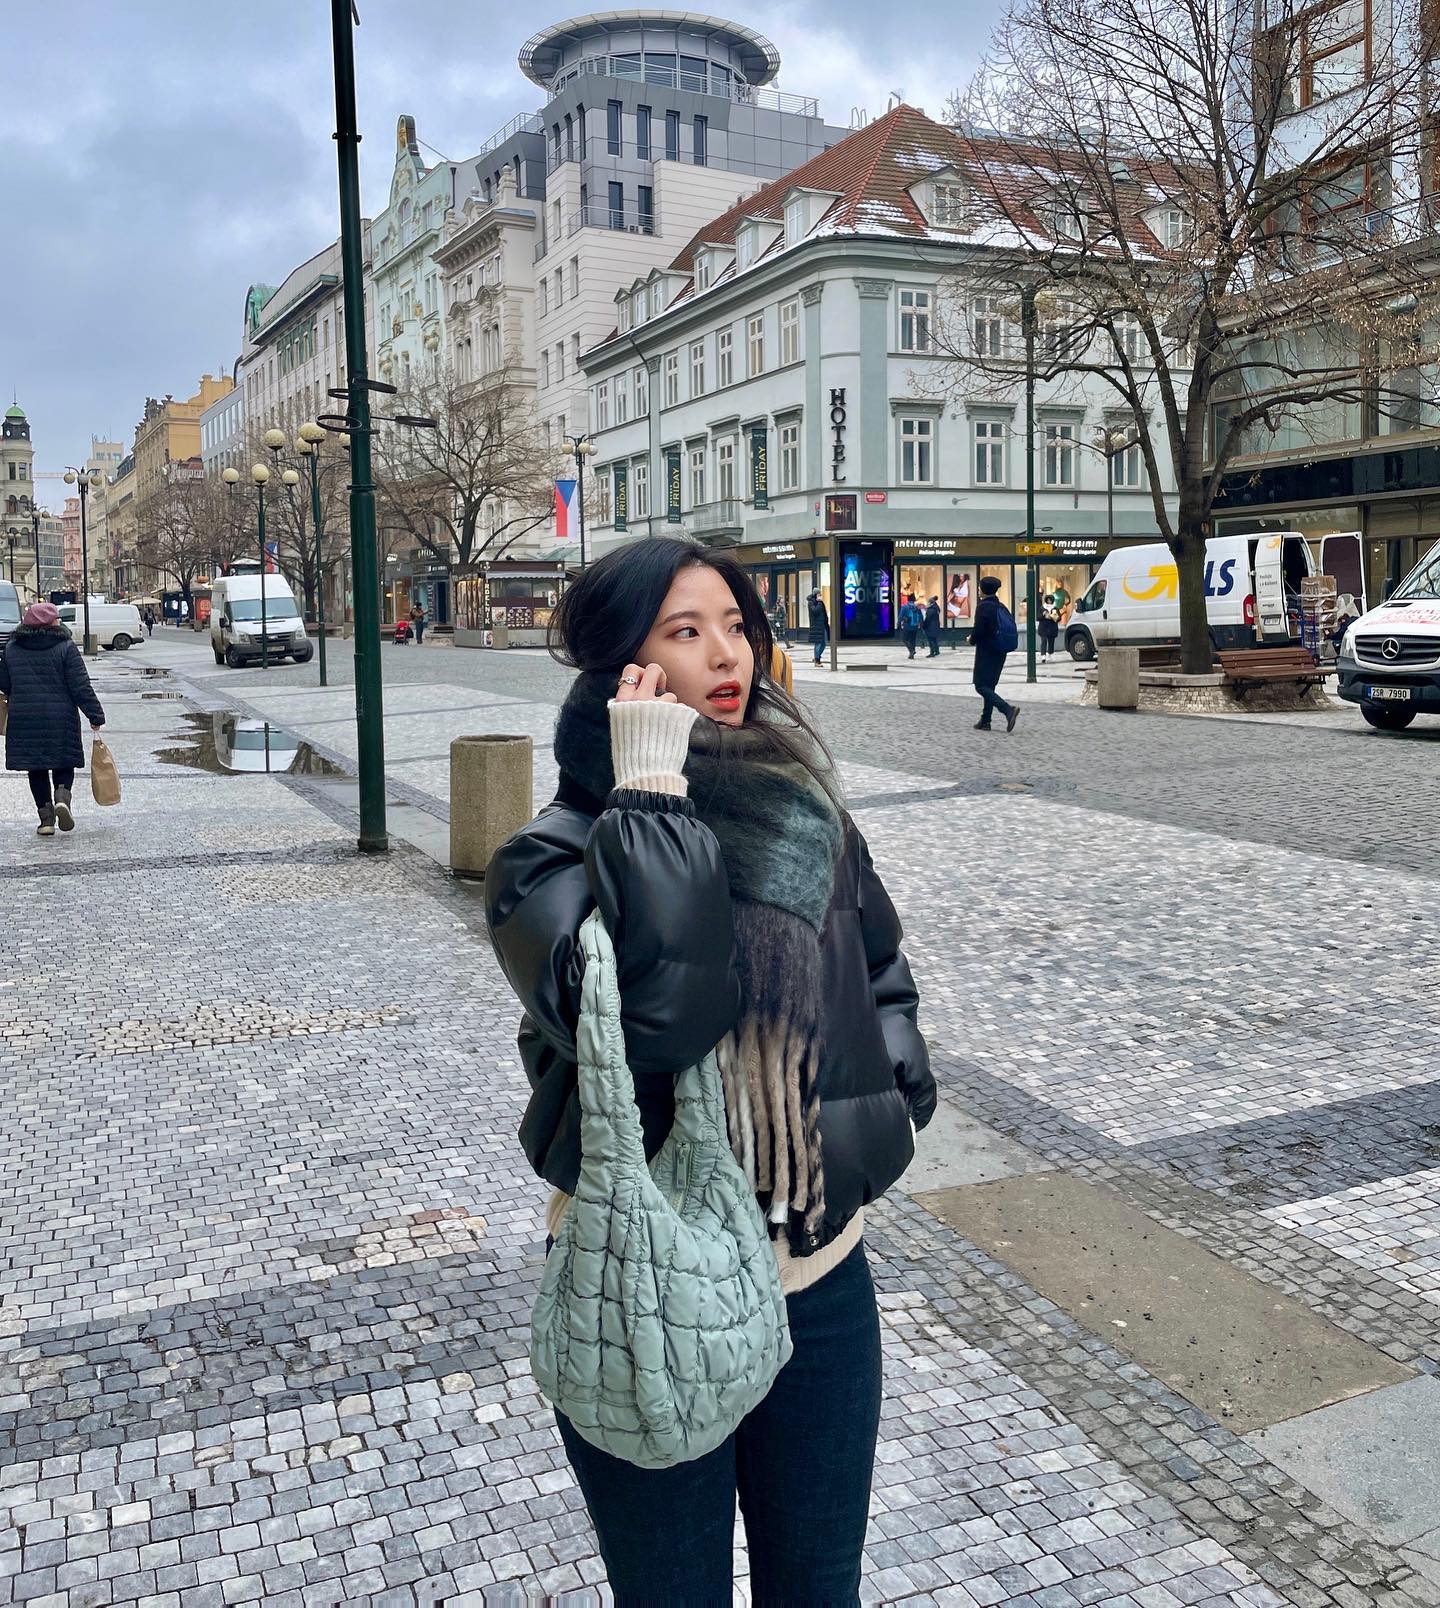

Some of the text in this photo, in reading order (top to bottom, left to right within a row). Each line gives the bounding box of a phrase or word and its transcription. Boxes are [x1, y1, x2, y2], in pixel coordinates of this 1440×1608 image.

[829, 388, 846, 481] HOTEL
[895, 540, 957, 548] intimissimi
[1204, 559, 1237, 596] LS
[845, 586, 889, 604] SOME
